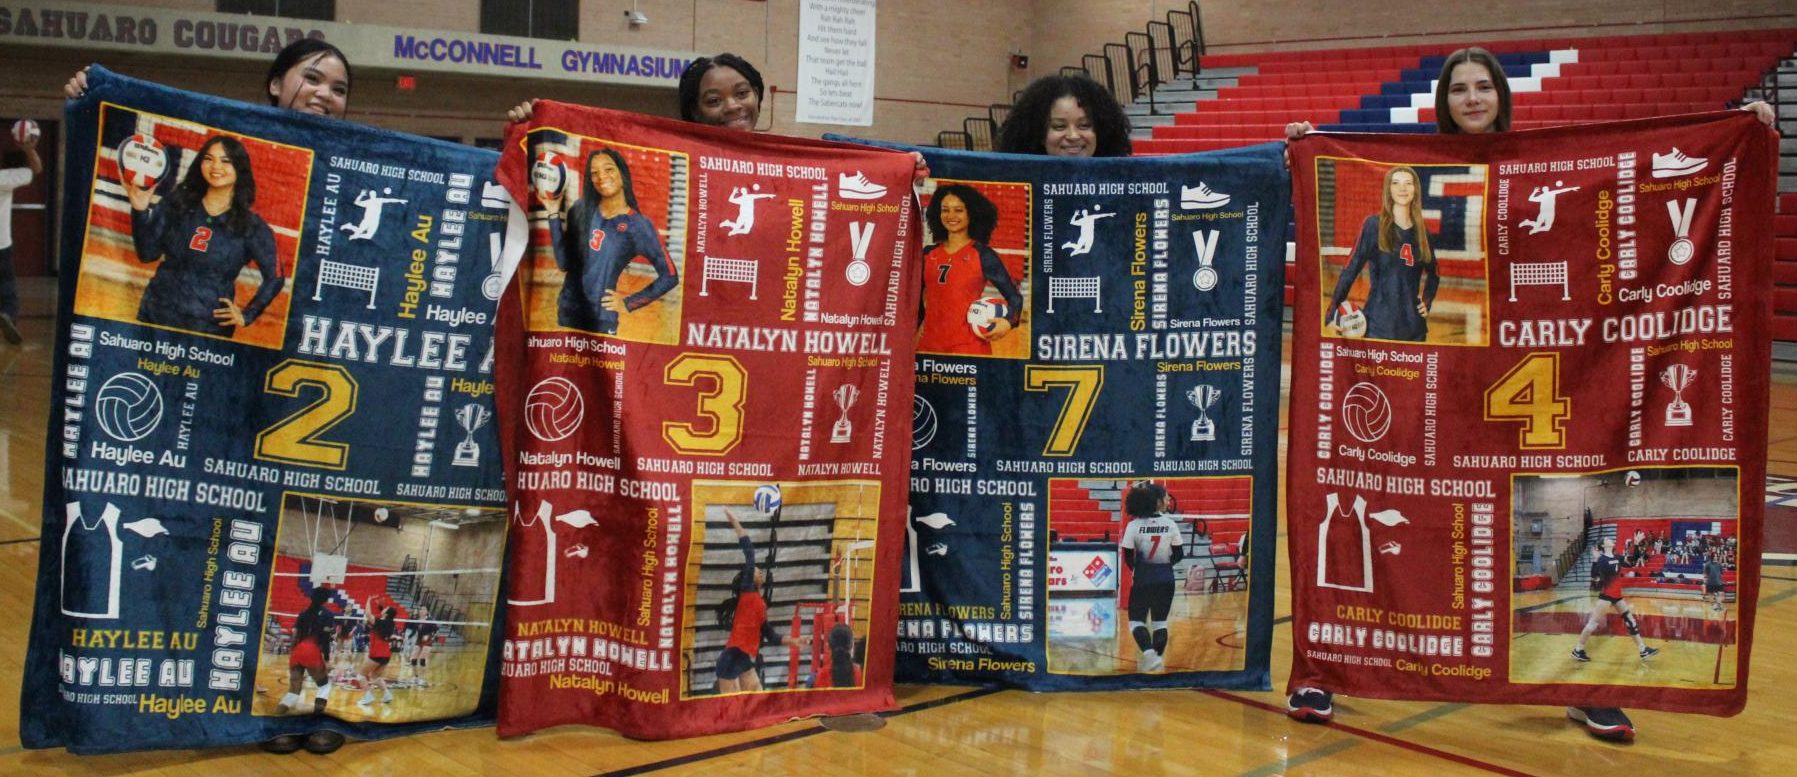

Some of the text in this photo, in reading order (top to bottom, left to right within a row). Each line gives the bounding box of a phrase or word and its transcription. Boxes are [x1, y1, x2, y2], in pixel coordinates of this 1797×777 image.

[561, 50, 691, 79] GYMNASIUM
[330, 156, 445, 185] SAHUARO HIGH SCHOOL
[700, 156, 828, 182] SAHUARO HIGH SCHOOL
[1500, 156, 1615, 174] SAHUARO HIGH SCHOOL
[1043, 182, 1169, 196] SAHUARO HIGH SCHOOL
[316, 173, 341, 255] HAYLEE AU
[1617, 151, 1637, 280] CARLY COOLIDGE
[1718, 157, 1736, 300] SAHUARO HIGH SCHOOL
[189, 226, 214, 253] 2
[430, 173, 474, 298] HAYLEE AU
[589, 229, 605, 251] 3
[1596, 190, 1615, 305] Carly Coolidge
[398, 215, 433, 318] Haylee Au
[780, 199, 804, 321] Natalyn Howell
[1244, 201, 1259, 326] SAHUARO HIGH SCHOOL
[1400, 243, 1414, 267] 4
[937, 264, 951, 284] 7
[1130, 212, 1147, 331] Sirena Flowers
[1618, 279, 1711, 303] Carly Coolidge
[1170, 317, 1240, 328] Sirena Flowers
[1500, 304, 1733, 347] CARLY COOLIDGE
[100, 331, 235, 367] Sahuaro High School
[297, 315, 471, 371] HAYLEE
[687, 323, 892, 354] NATALYN HOWELL
[1038, 330, 1257, 360] SIRENA FLOWERS
[1157, 360, 1241, 373] Sirena Flowers
[253, 357, 359, 471] 2
[662, 352, 748, 456] 3
[1024, 364, 1104, 457] 7
[1242, 357, 1254, 456] SIRENA FLOWERS
[1483, 351, 1571, 450] 4
[91, 441, 186, 468] Haylee Au
[520, 451, 621, 470] Natalyn Howell
[637, 457, 774, 477] SAHUARO HIGH SCHOOL
[798, 462, 881, 476] NATALYN HOWELL
[996, 460, 1135, 474] SAHUARO HIGH SCHOOL
[1338, 444, 1416, 467] Carly Coolidge
[1453, 454, 1606, 468] SAHUARO HIGH SCHOOL
[1628, 447, 1736, 462] CARLY COOLIDGE
[62, 467, 267, 513] AHUARO HIGH SCHOOL
[204, 457, 381, 495] SAHUARO HIGH SCHOOL
[1317, 467, 1496, 498] SAHUARO HIGH SCHOOL
[1139, 526, 1169, 534] FLOWERS
[1000, 502, 1014, 620] Sahuaro High School
[1148, 535, 1161, 560] 7
[1452, 503, 1467, 610] Sahuaro High School
[1471, 502, 1494, 657] CARLY COOLIDGE
[208, 518, 263, 691] HAYLEE AU
[1337, 604, 1462, 631] CARLY COOLIDGE
[72, 628, 199, 651] HAYLEE AU
[518, 619, 649, 646] NATALYN HOWELL
[1308, 622, 1464, 657] CARLY COOLIDGE
[928, 656, 1036, 673] Sirena Flowers
[550, 674, 669, 704] Natalyn Howell
[139, 694, 241, 720] Haylee Au
